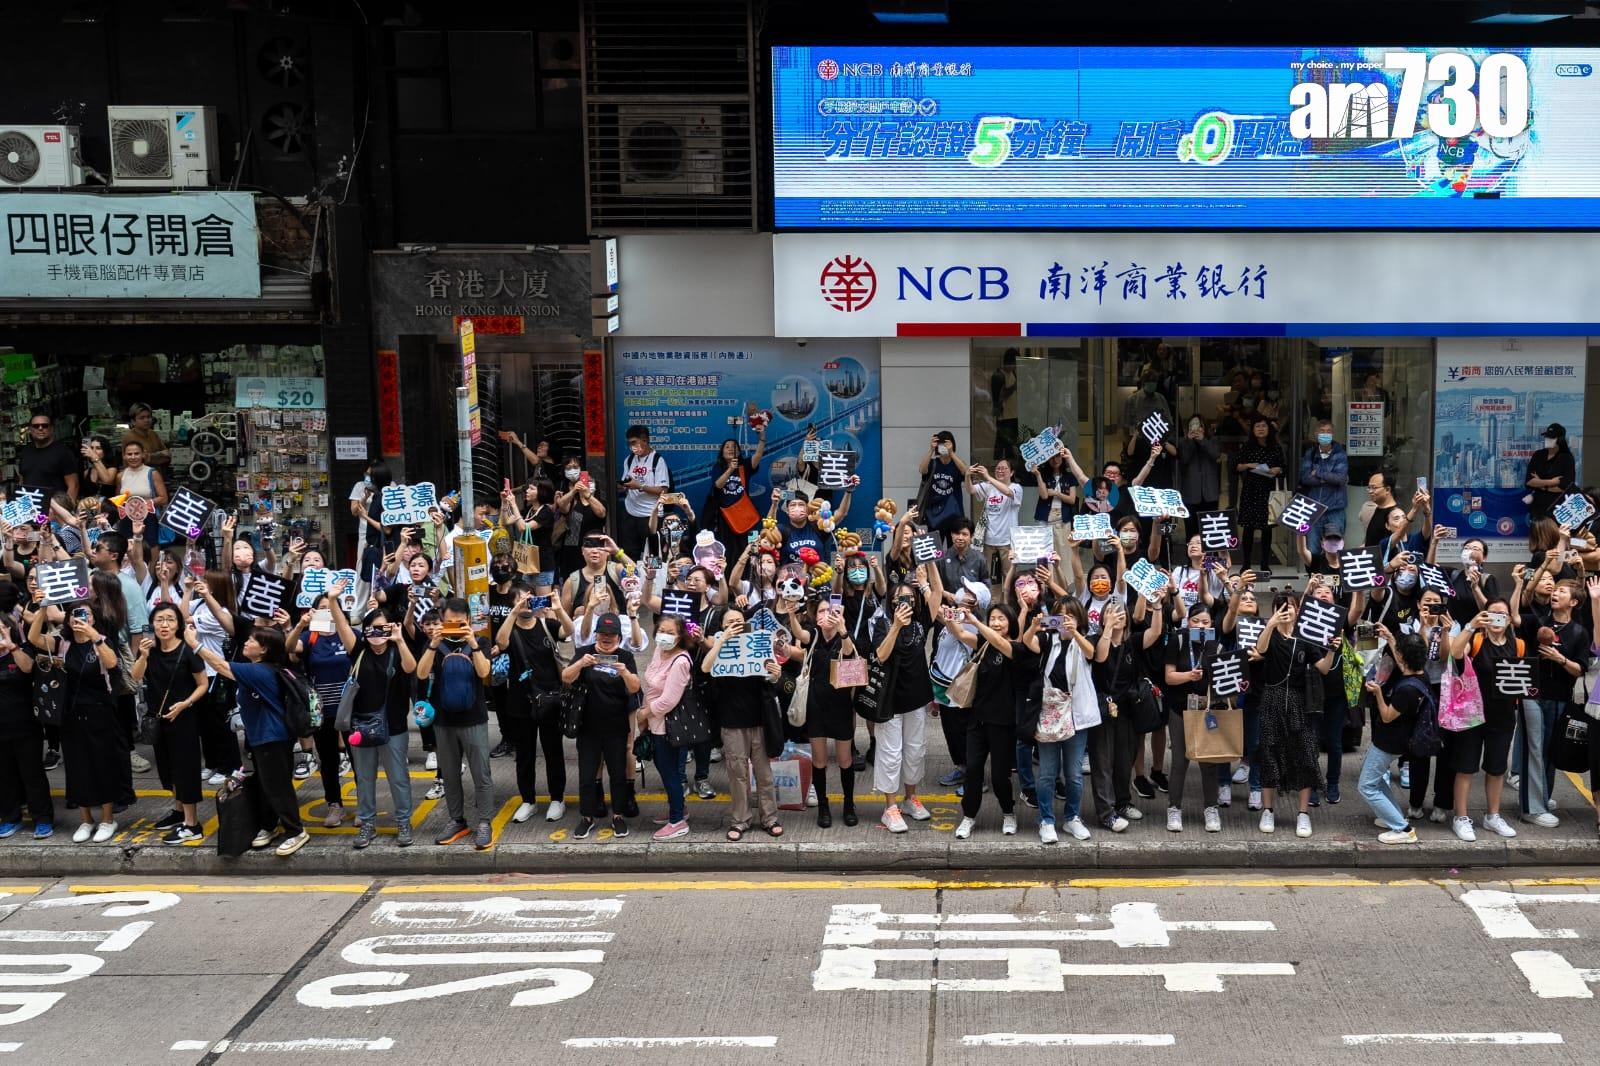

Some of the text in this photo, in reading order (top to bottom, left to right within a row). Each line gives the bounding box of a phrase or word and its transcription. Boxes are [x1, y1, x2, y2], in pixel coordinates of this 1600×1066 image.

[843, 62, 972, 78] NCB 南洋商業銀行
[1439, 143, 1465, 159] NCB
[7, 213, 235, 258] 四眼仔開倉
[47, 264, 205, 282] 手機電腦配件專賣店
[424, 269, 550, 299] 香港大廈
[896, 260, 1268, 307] NCB 南洋商業銀行
[416, 305, 561, 316] HONG KONG MANSION
[1460, 365, 1482, 377] 南商
[1484, 365, 1574, 377] 您的人民幣金融管家
[623, 375, 718, 387] 手續全程可在港辦理
[277, 390, 314, 407] $20
[384, 484, 433, 511] 姜濤
[382, 512, 412, 525] Keung
[712, 662, 762, 676] Keung To
[0, 890, 182, 1026] ST
[296, 895, 625, 1009] BUS
